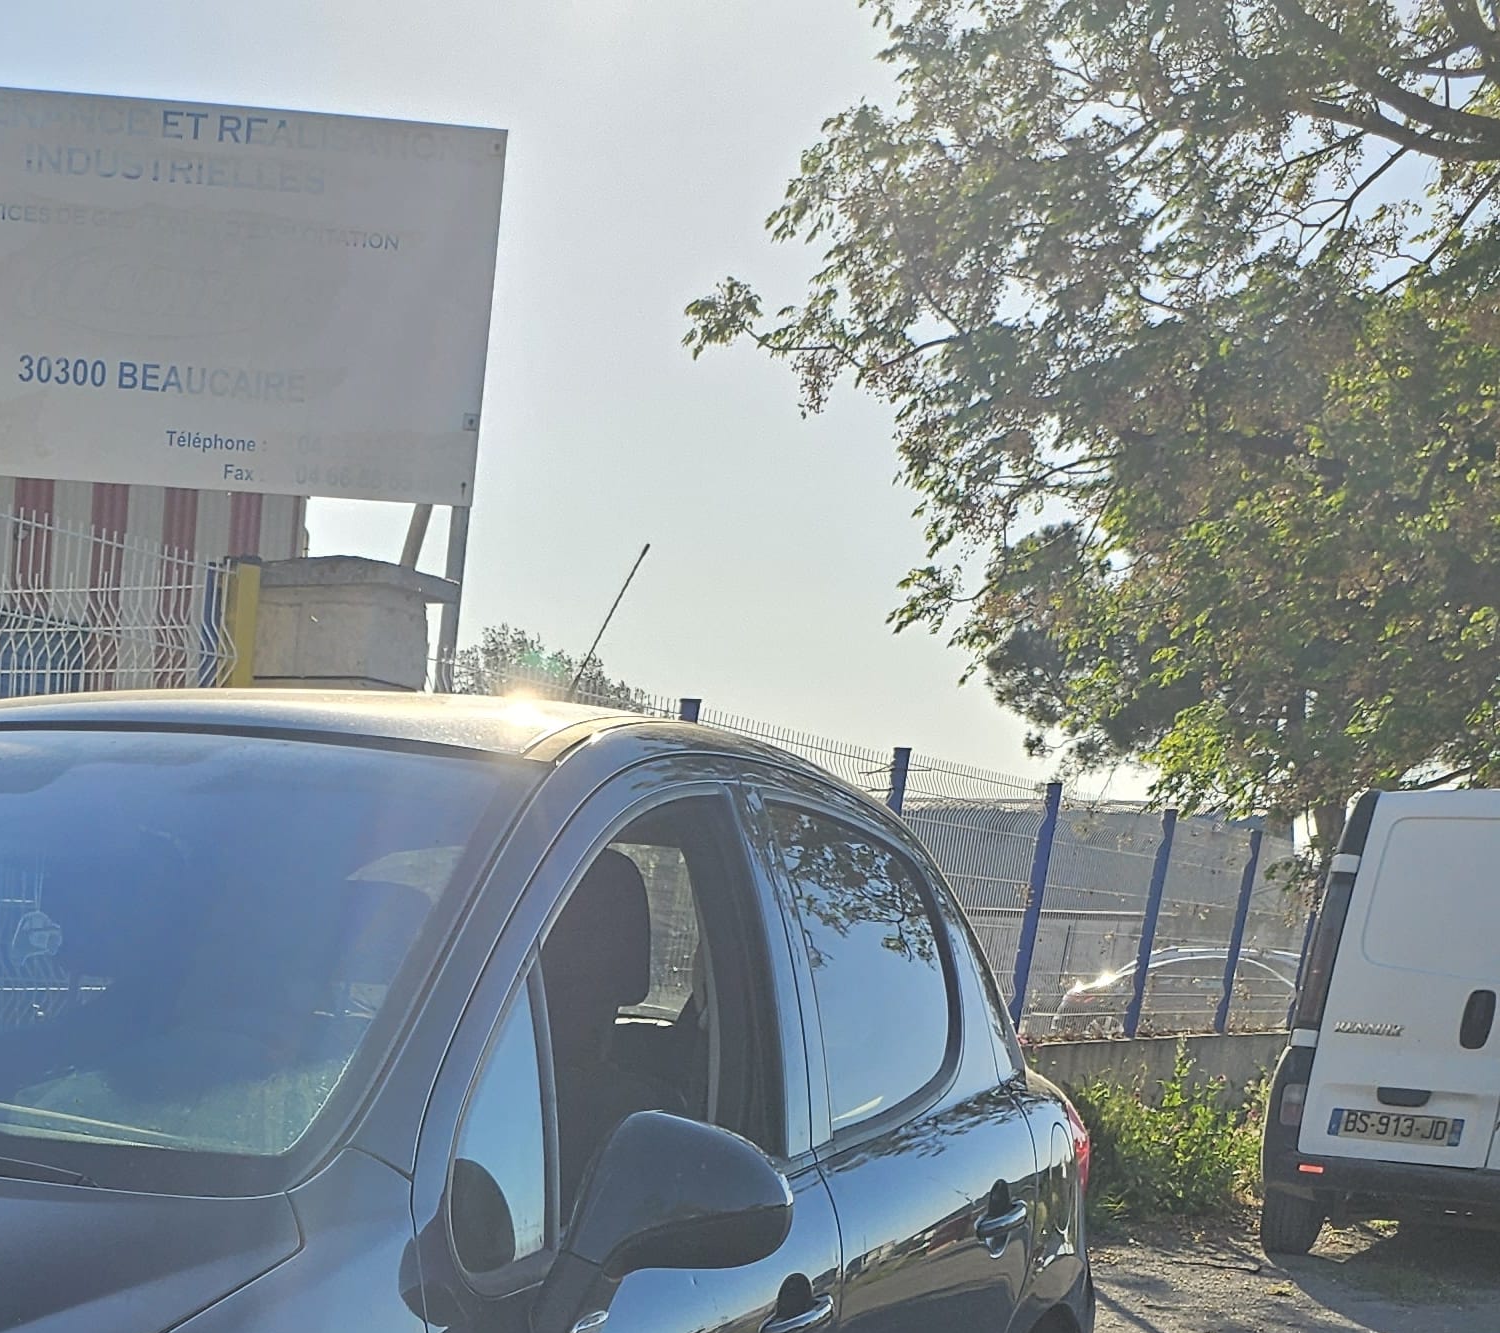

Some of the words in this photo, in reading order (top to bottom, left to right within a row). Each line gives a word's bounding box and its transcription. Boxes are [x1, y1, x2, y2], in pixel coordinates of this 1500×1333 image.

[161, 110, 209, 140] ET
[17, 353, 108, 389] 30300
[117, 360, 306, 404] BEAUCAIRE
[223, 464, 255, 482] Fax
